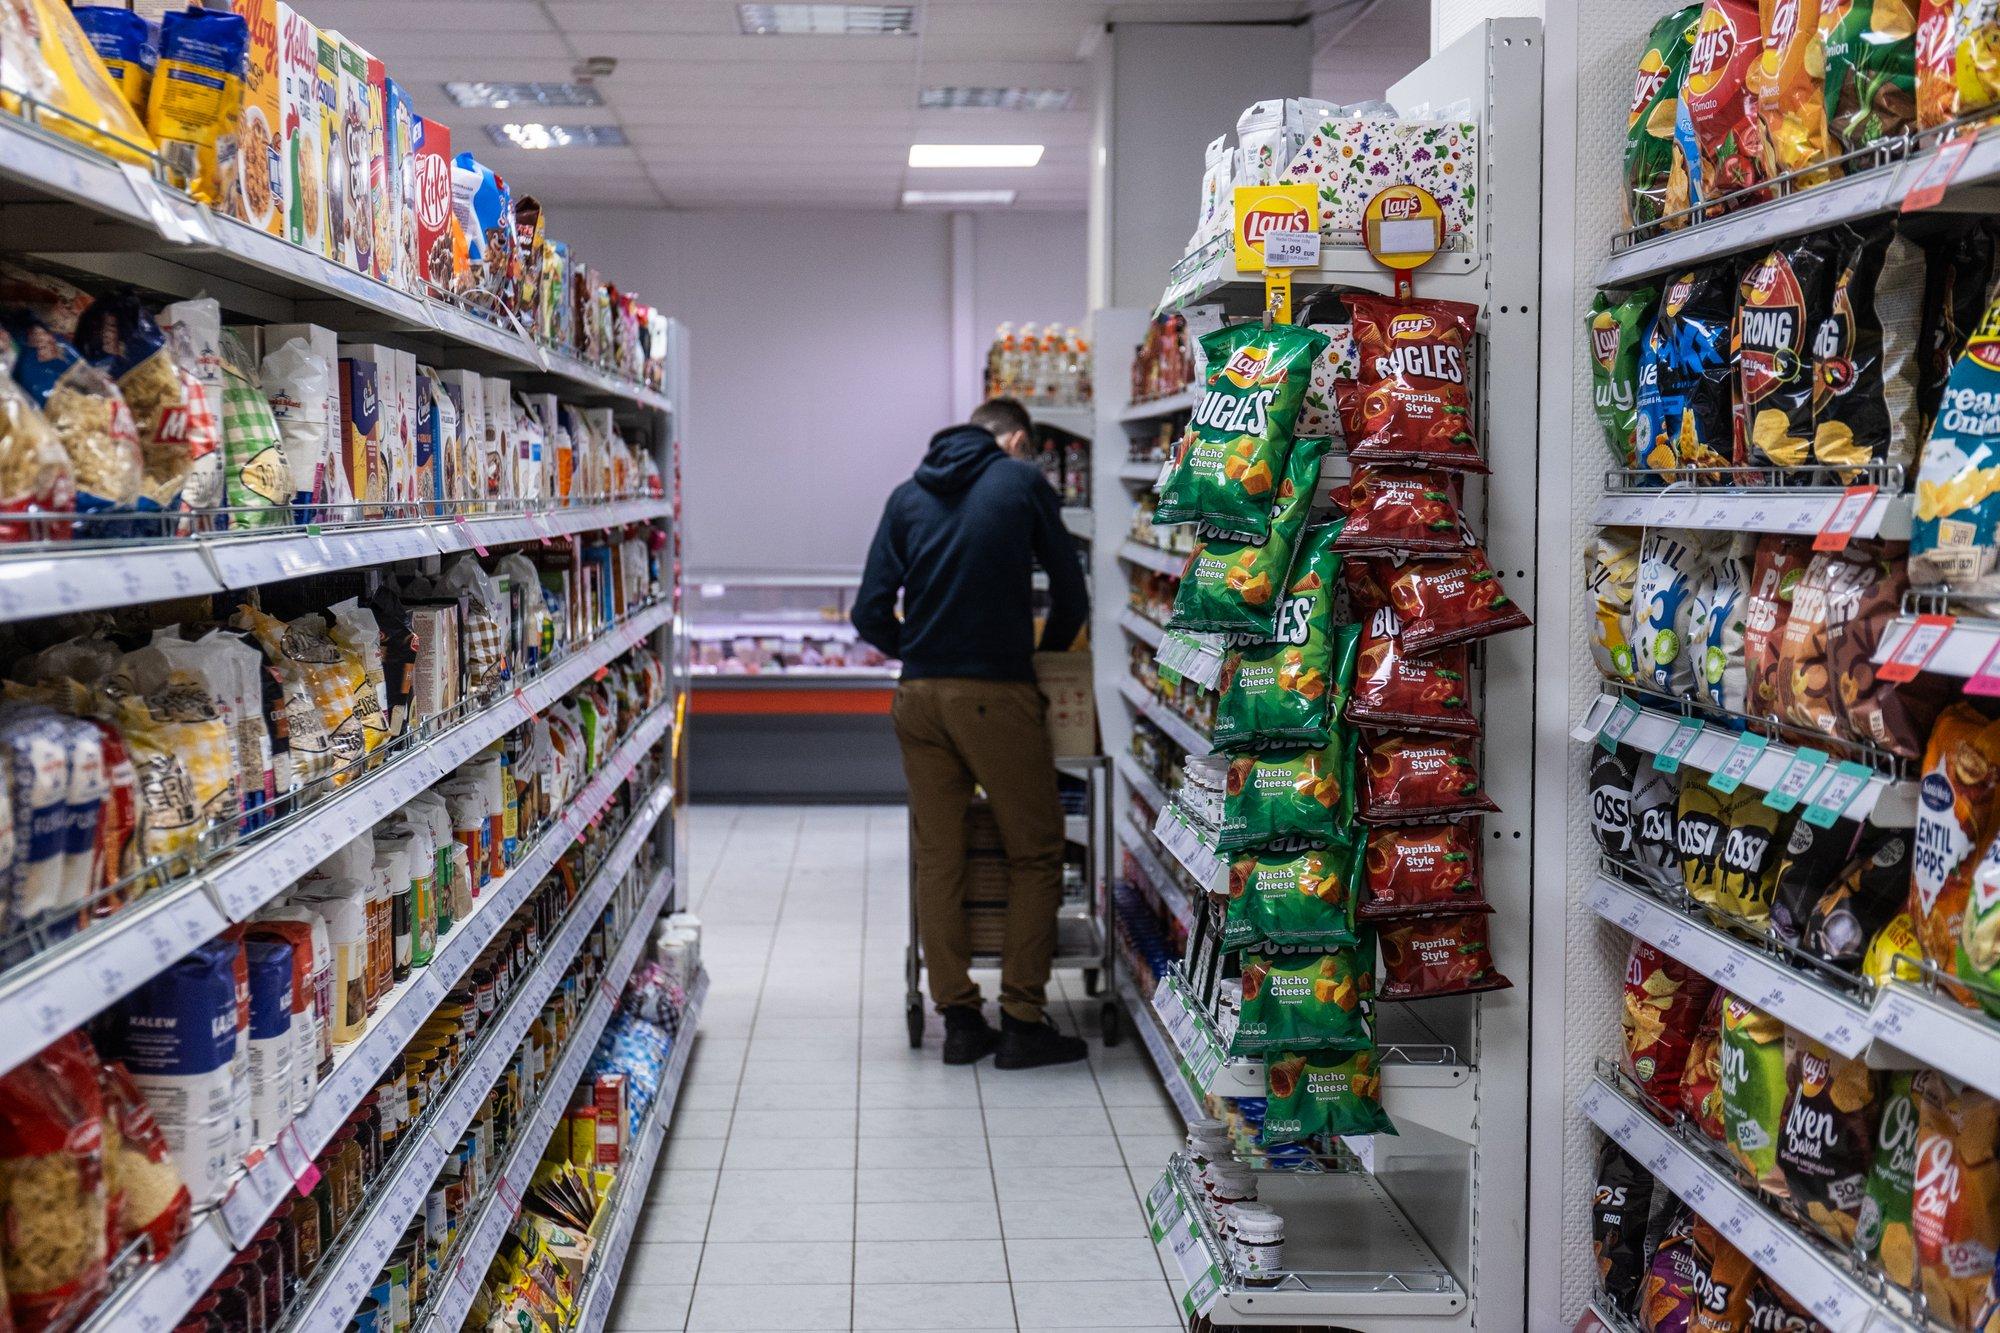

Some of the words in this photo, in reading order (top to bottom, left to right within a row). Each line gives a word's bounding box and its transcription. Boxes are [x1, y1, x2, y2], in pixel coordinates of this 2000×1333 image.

[1691, 99, 1718, 113] Tomato
[420, 156, 449, 224] KitKat
[1383, 194, 1421, 218] Lay's
[1281, 244, 1301, 255] 1,99
[1390, 317, 1433, 339] Lay's
[1398, 392, 1441, 404] Paprika
[1193, 389, 1273, 435] UGLES
[1405, 402, 1434, 413] Style
[1193, 447, 1224, 459] Nacho
[1189, 458, 1224, 469] Cheese
[1379, 480, 1423, 491] Paprika
[1386, 490, 1415, 500] Style
[1199, 558, 1227, 569] Nacho
[1194, 568, 1225, 580] Cheese
[1425, 567, 1468, 585] Paprika
[1436, 580, 1465, 594] Style
[1241, 666, 1274, 677] Nacho
[1398, 666, 1427, 678] Style
[1239, 677, 1275, 688] Cheese
[1402, 747, 1446, 759] Paprika
[1411, 759, 1440, 770] Style
[1257, 769, 1293, 779] Nacho
[1254, 779, 1294, 789] Cheese
[1678, 819, 1720, 856] OSSI
[1918, 816, 1953, 855] ENTIL
[1397, 844, 1441, 856] Paprika
[1724, 829, 1770, 873] OSSI
[1406, 856, 1435, 867] Style
[1915, 844, 1945, 883] POPS
[1258, 870, 1295, 881] Nacho
[1255, 881, 1296, 891] Cheese
[1412, 937, 1456, 951] Paprika
[1421, 951, 1450, 963] Style
[1271, 975, 1309, 986] Nacho
[1270, 986, 1311, 996] Cheese
[129, 1016, 178, 1029] KALEW
[1722, 1040, 1749, 1084] ven
[1308, 1072, 1346, 1083] Nacho
[1306, 1083, 1348, 1094] Cheese
[1789, 1131, 1822, 1159] Baked
[1603, 1213, 1622, 1226] BBQ
